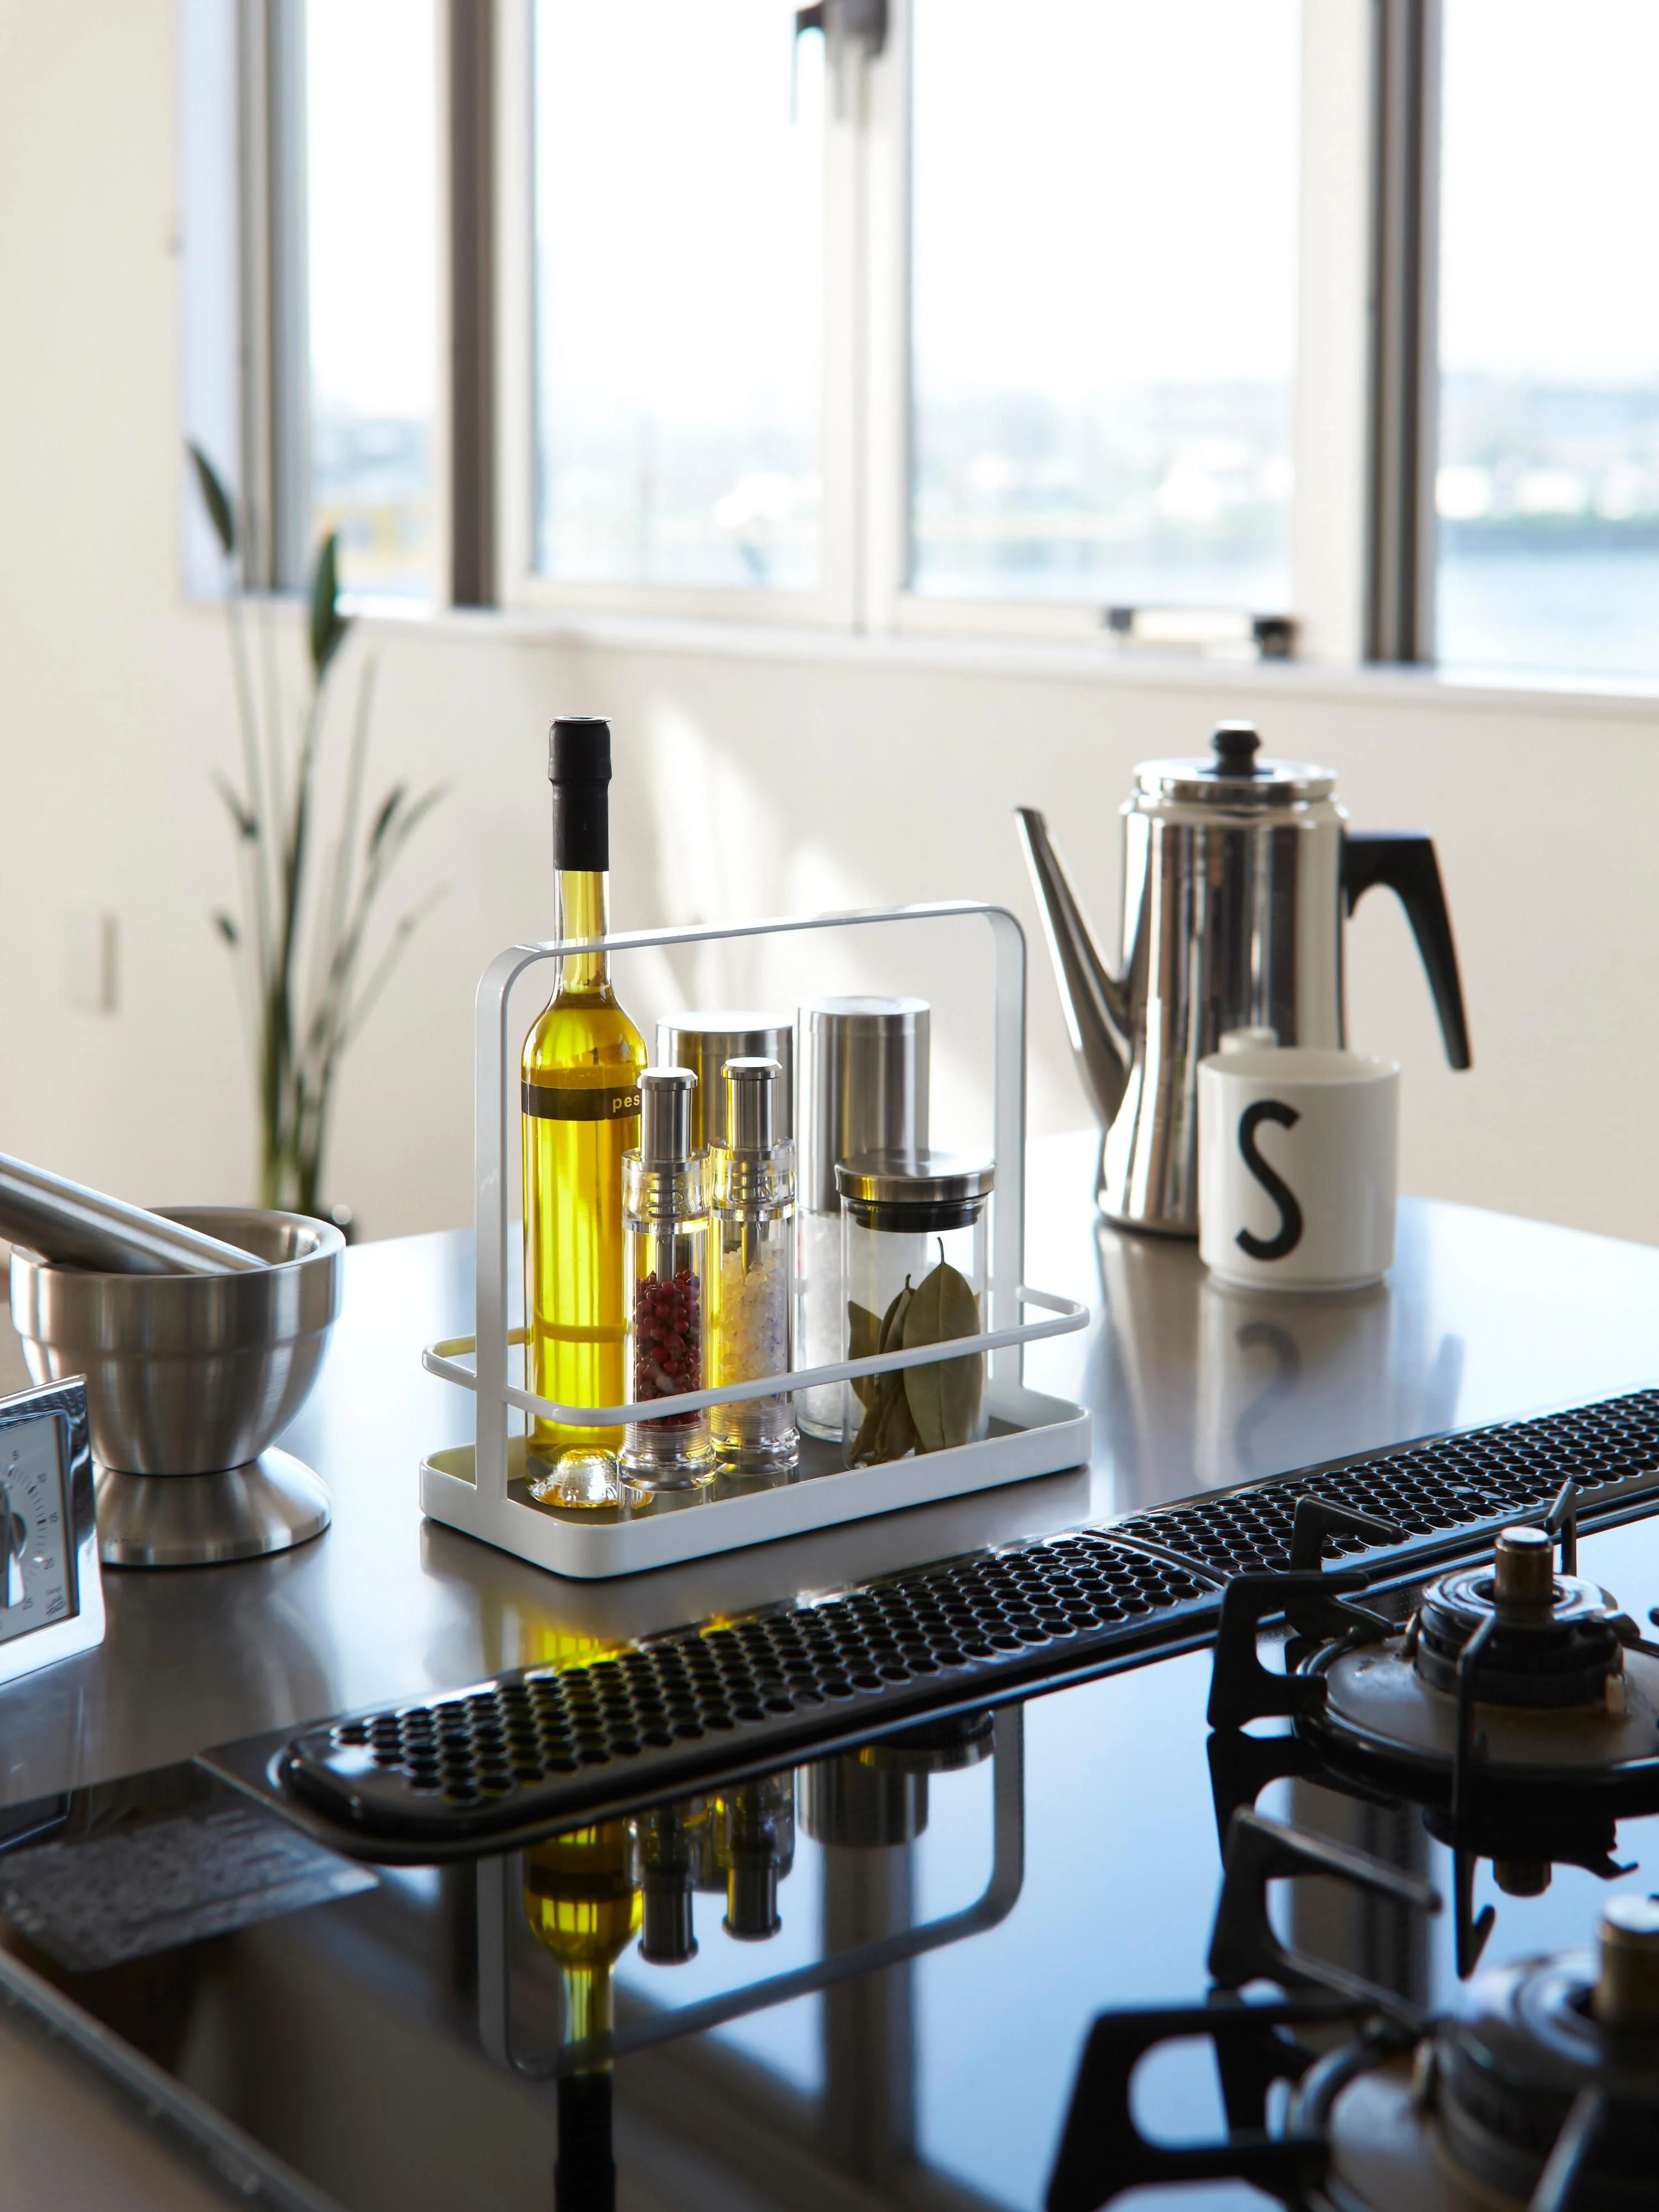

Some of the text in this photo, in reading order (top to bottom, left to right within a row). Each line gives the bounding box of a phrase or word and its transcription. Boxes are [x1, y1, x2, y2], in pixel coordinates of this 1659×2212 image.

[1234, 1099, 1303, 1262] S
[12, 1449, 19, 1461] 5
[37, 1472, 48, 1484] 10
[49, 1512, 59, 1524] 15
[44, 1557, 55, 1570] 20
